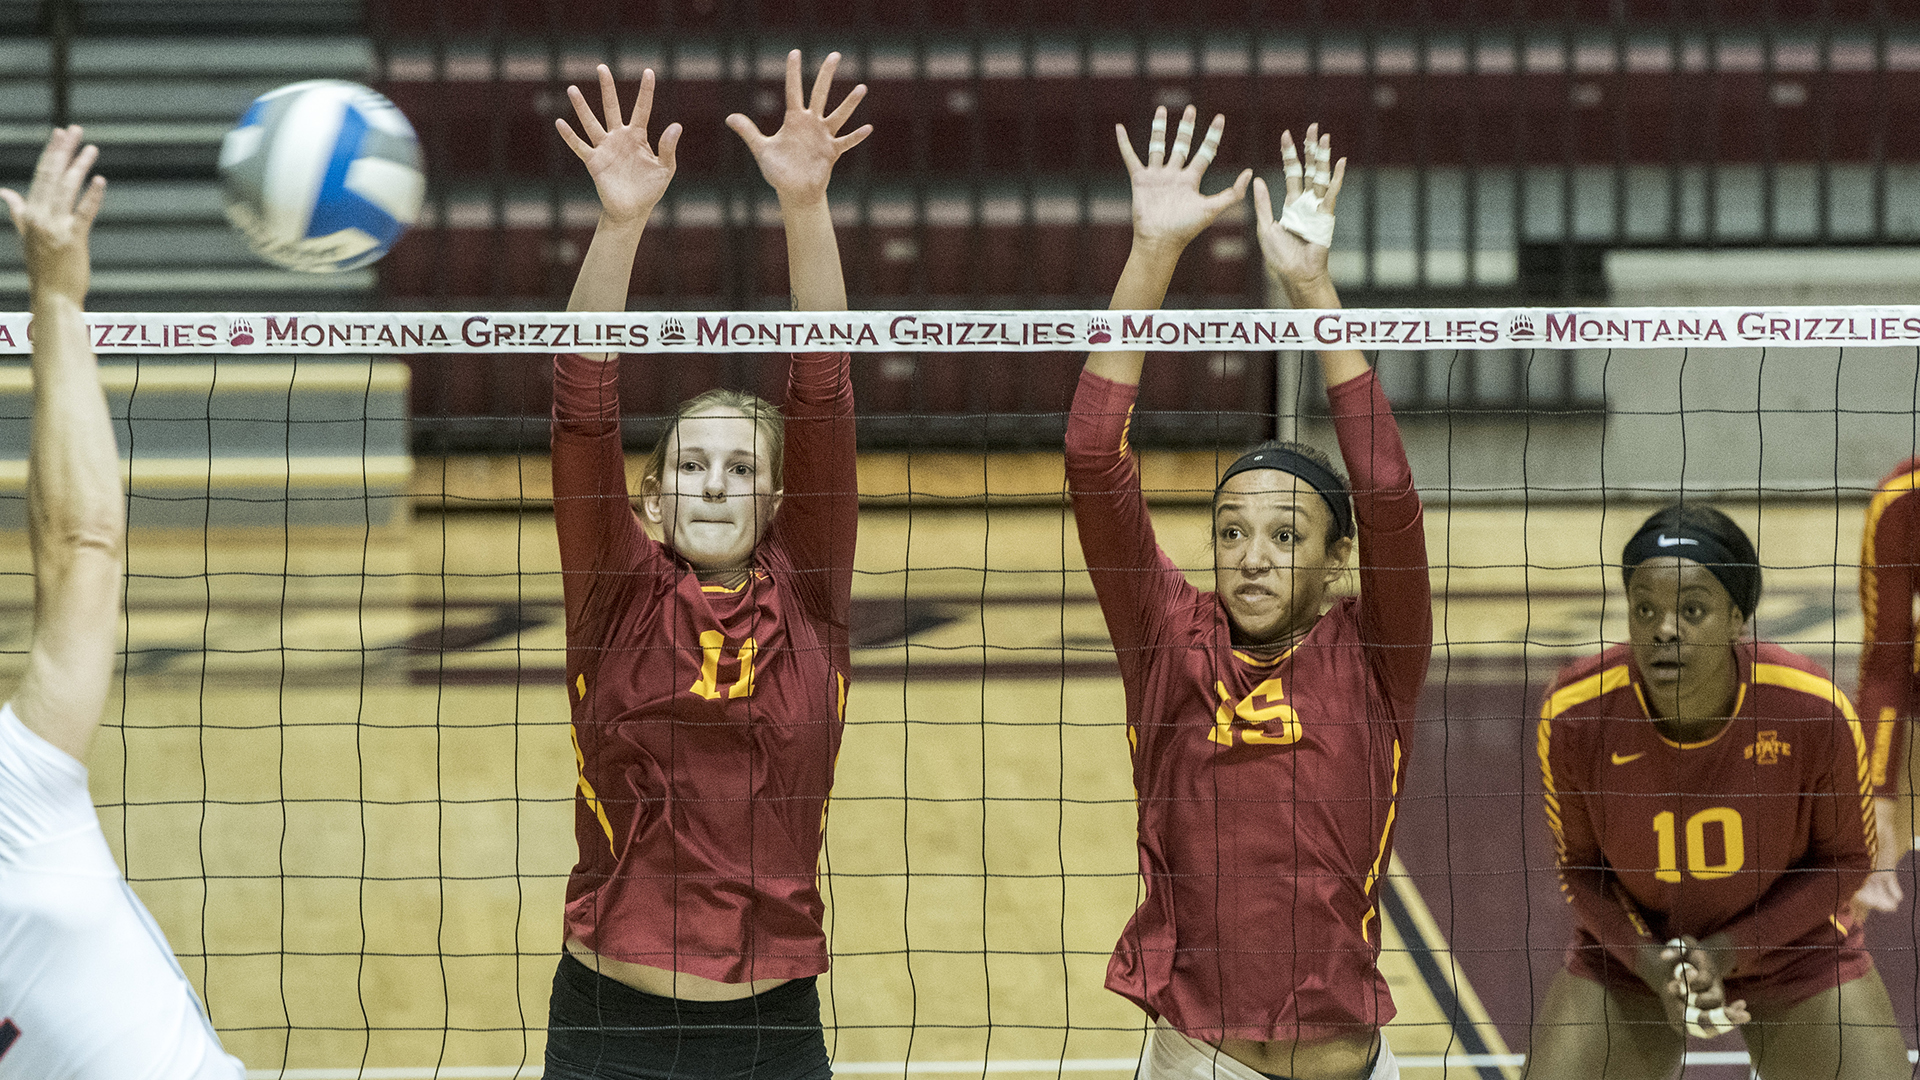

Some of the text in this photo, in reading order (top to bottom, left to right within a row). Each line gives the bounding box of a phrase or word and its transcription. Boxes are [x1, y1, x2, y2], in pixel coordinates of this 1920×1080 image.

[27, 319, 217, 347] IZZLIES
[265, 316, 453, 347] MONTANA
[461, 316, 649, 347] GRIZZLIES
[696, 316, 879, 346] MONTANA
[889, 315, 1076, 346] GRIZZLIES
[1121, 314, 1304, 344] MONTANA
[1313, 314, 1500, 344] GRIZZLIES
[1545, 313, 1728, 343] MONTANA
[1737, 312, 1920, 342] GRIZZLIES
[689, 629, 759, 700] 11
[1206, 677, 1303, 747] 15
[1652, 806, 1745, 883] 10
